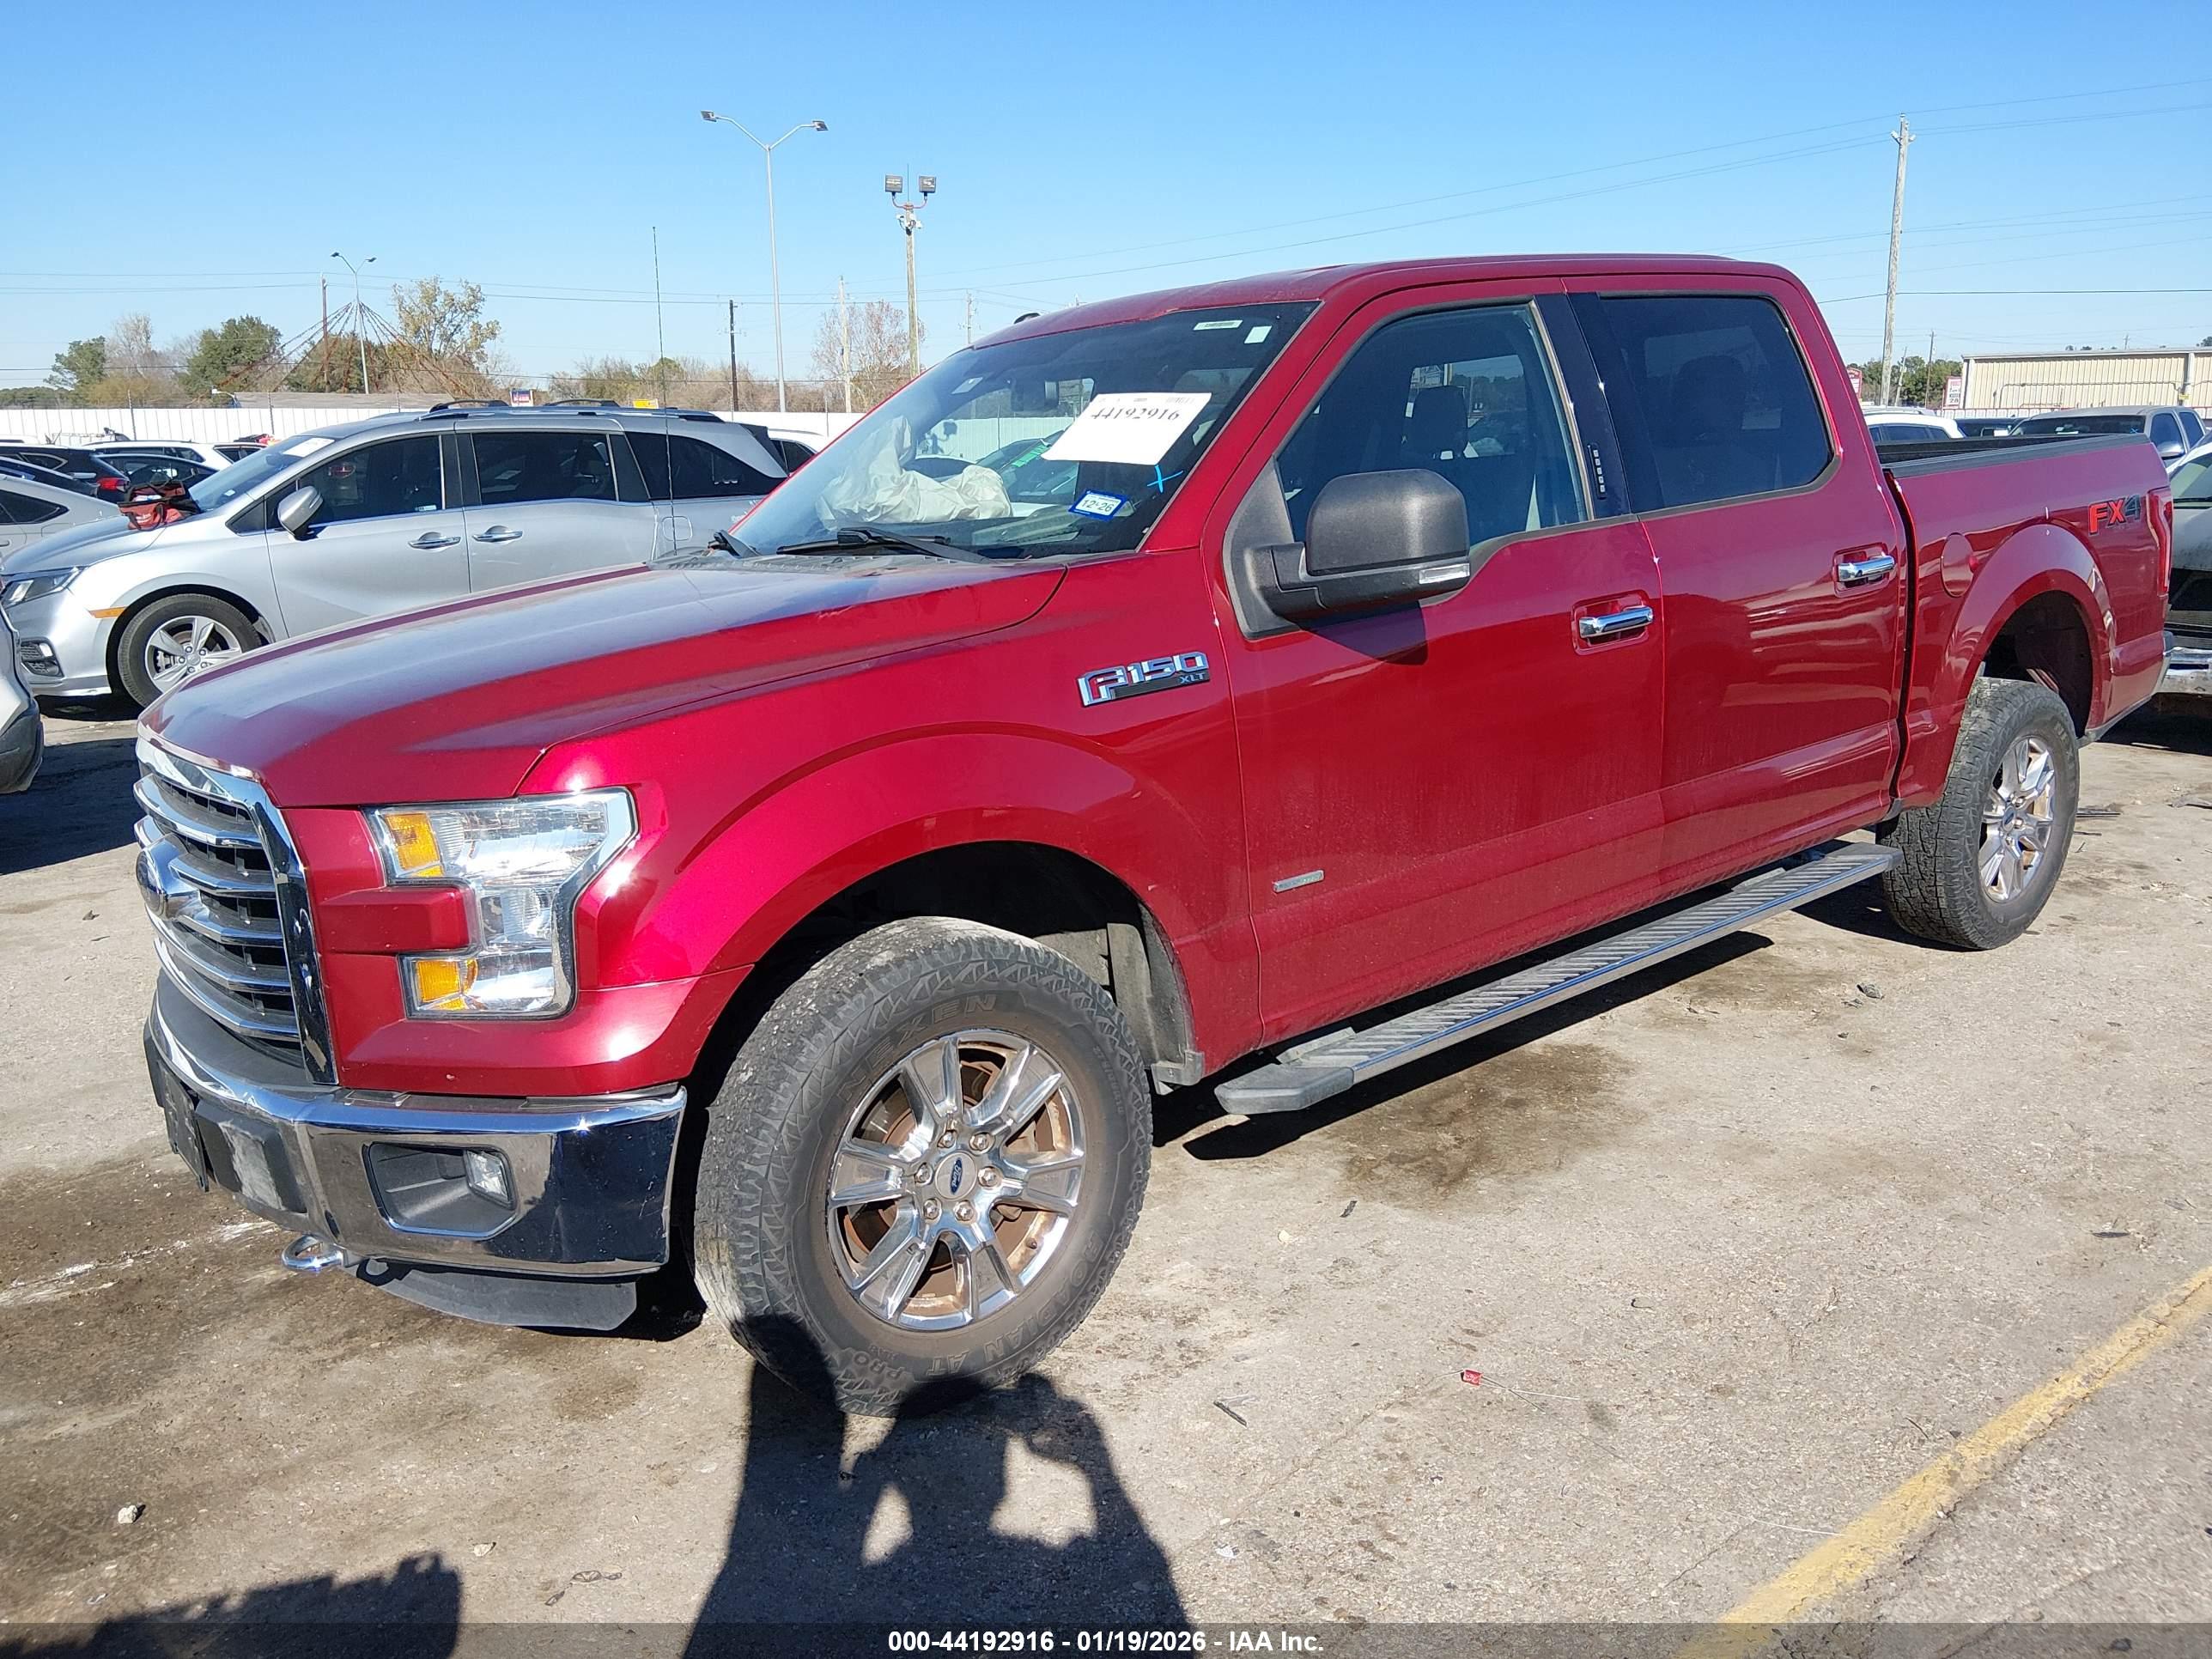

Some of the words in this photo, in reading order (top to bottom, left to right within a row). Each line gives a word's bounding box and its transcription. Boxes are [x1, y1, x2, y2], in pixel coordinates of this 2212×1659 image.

[1091, 406, 1182, 421] 44192916
[2088, 494, 2141, 535] FX4
[1179, 672, 1206, 684] XLT
[836, 994, 997, 1102] NEXEN
[951, 1164, 962, 1188] Ford
[983, 1233, 1105, 1363] ROADIAN
[852, 1351, 906, 1379] PRO
[926, 1351, 969, 1376] AT
